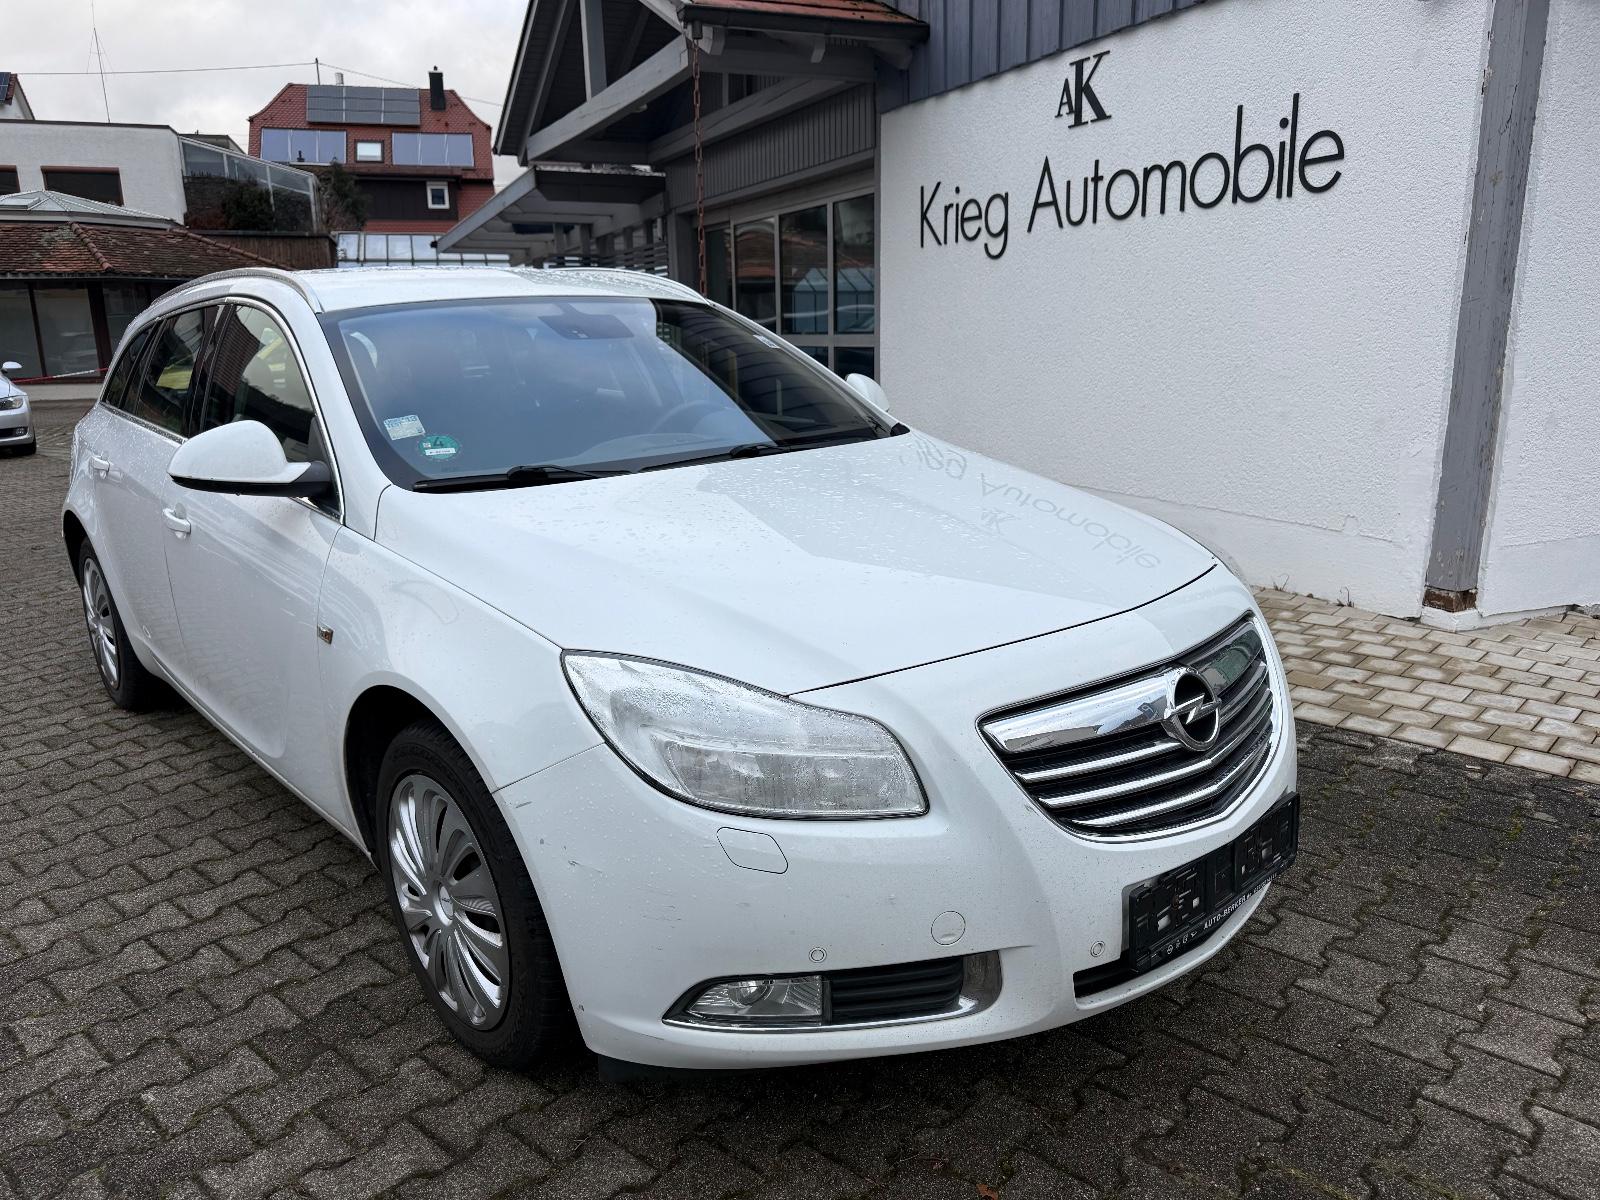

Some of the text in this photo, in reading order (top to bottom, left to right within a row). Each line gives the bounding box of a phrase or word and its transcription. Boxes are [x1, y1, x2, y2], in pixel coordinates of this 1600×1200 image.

[1055, 50, 1112, 129] AK
[920, 92, 1345, 260] Krieg Automobile
